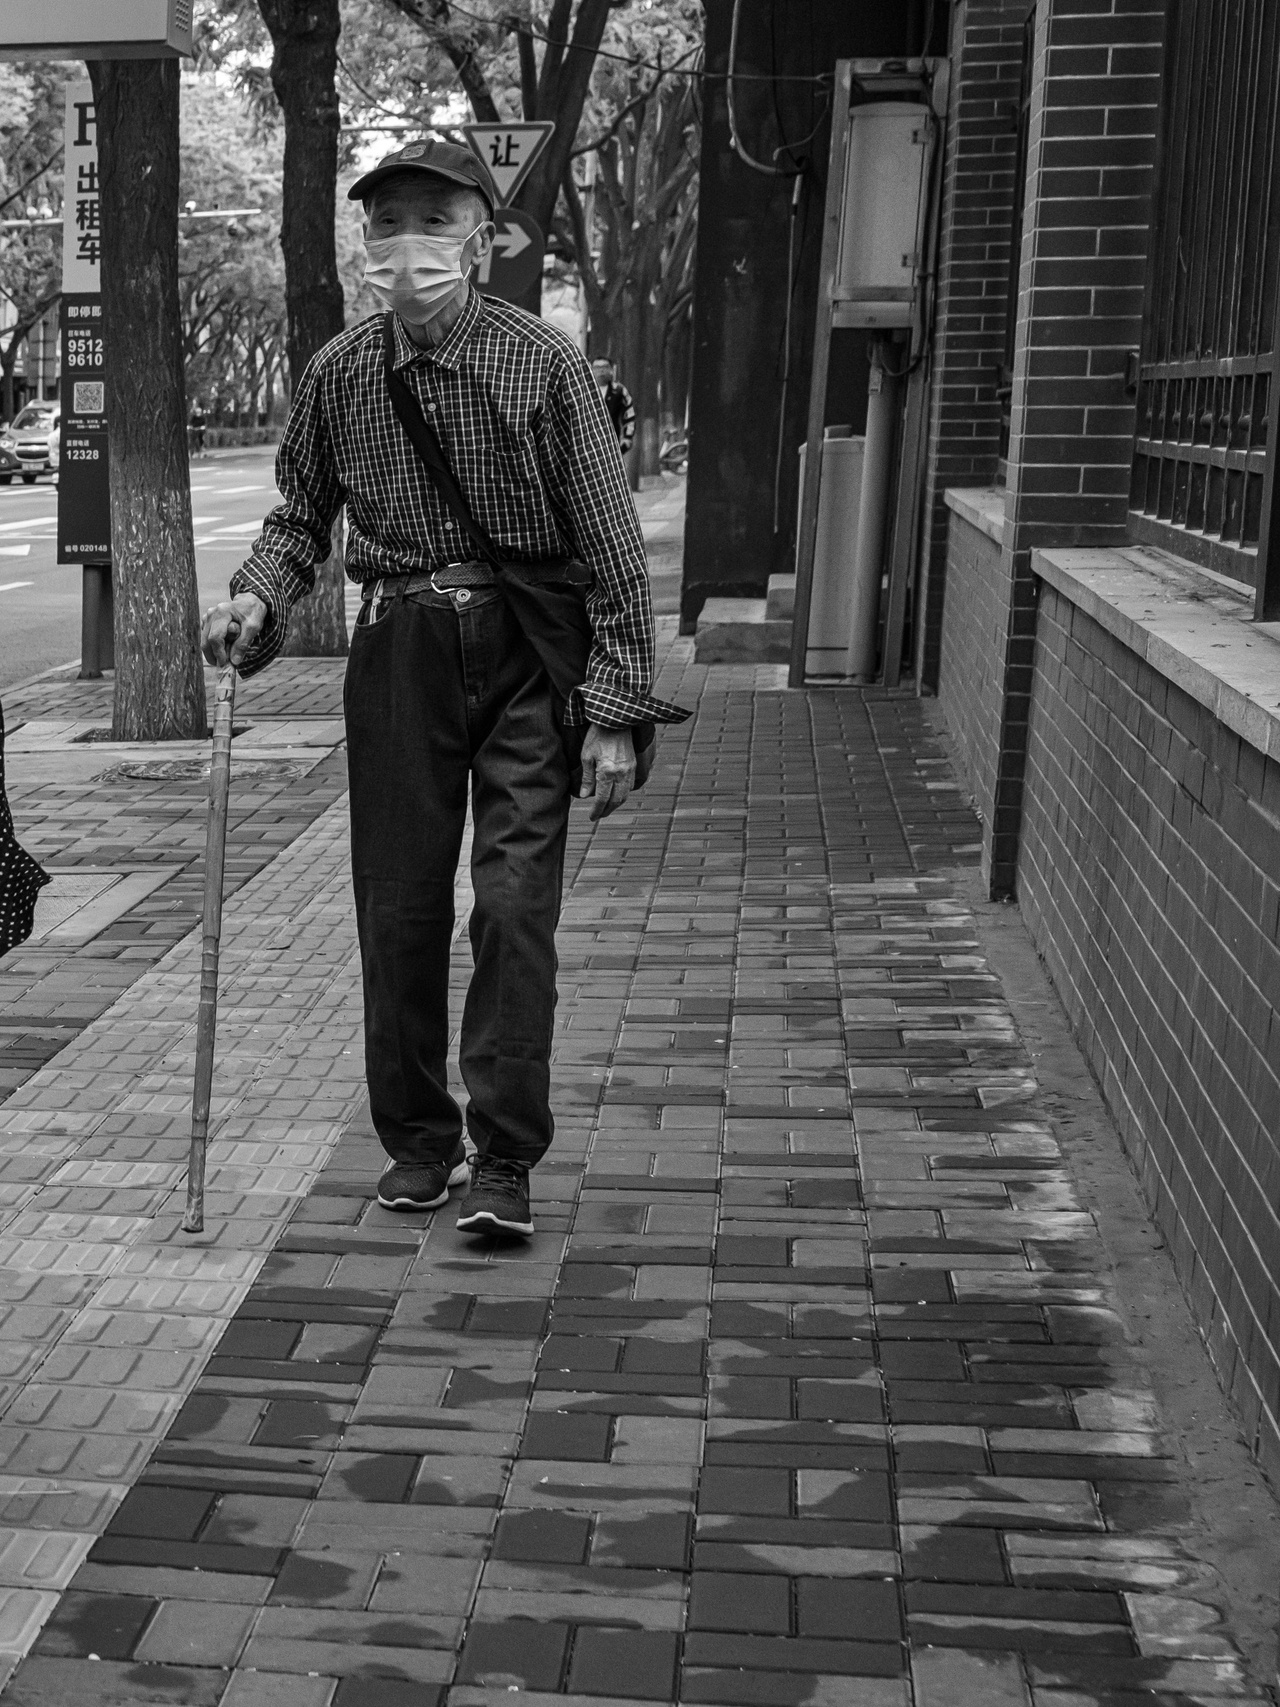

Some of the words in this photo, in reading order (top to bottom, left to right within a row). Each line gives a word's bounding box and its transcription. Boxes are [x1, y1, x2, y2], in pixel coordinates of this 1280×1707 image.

[489, 134, 520, 167] 让
[76, 161, 100, 265] 出租车
[67, 338, 103, 353] 9512
[67, 352, 103, 367] 9610
[66, 449, 99, 460] 12328
